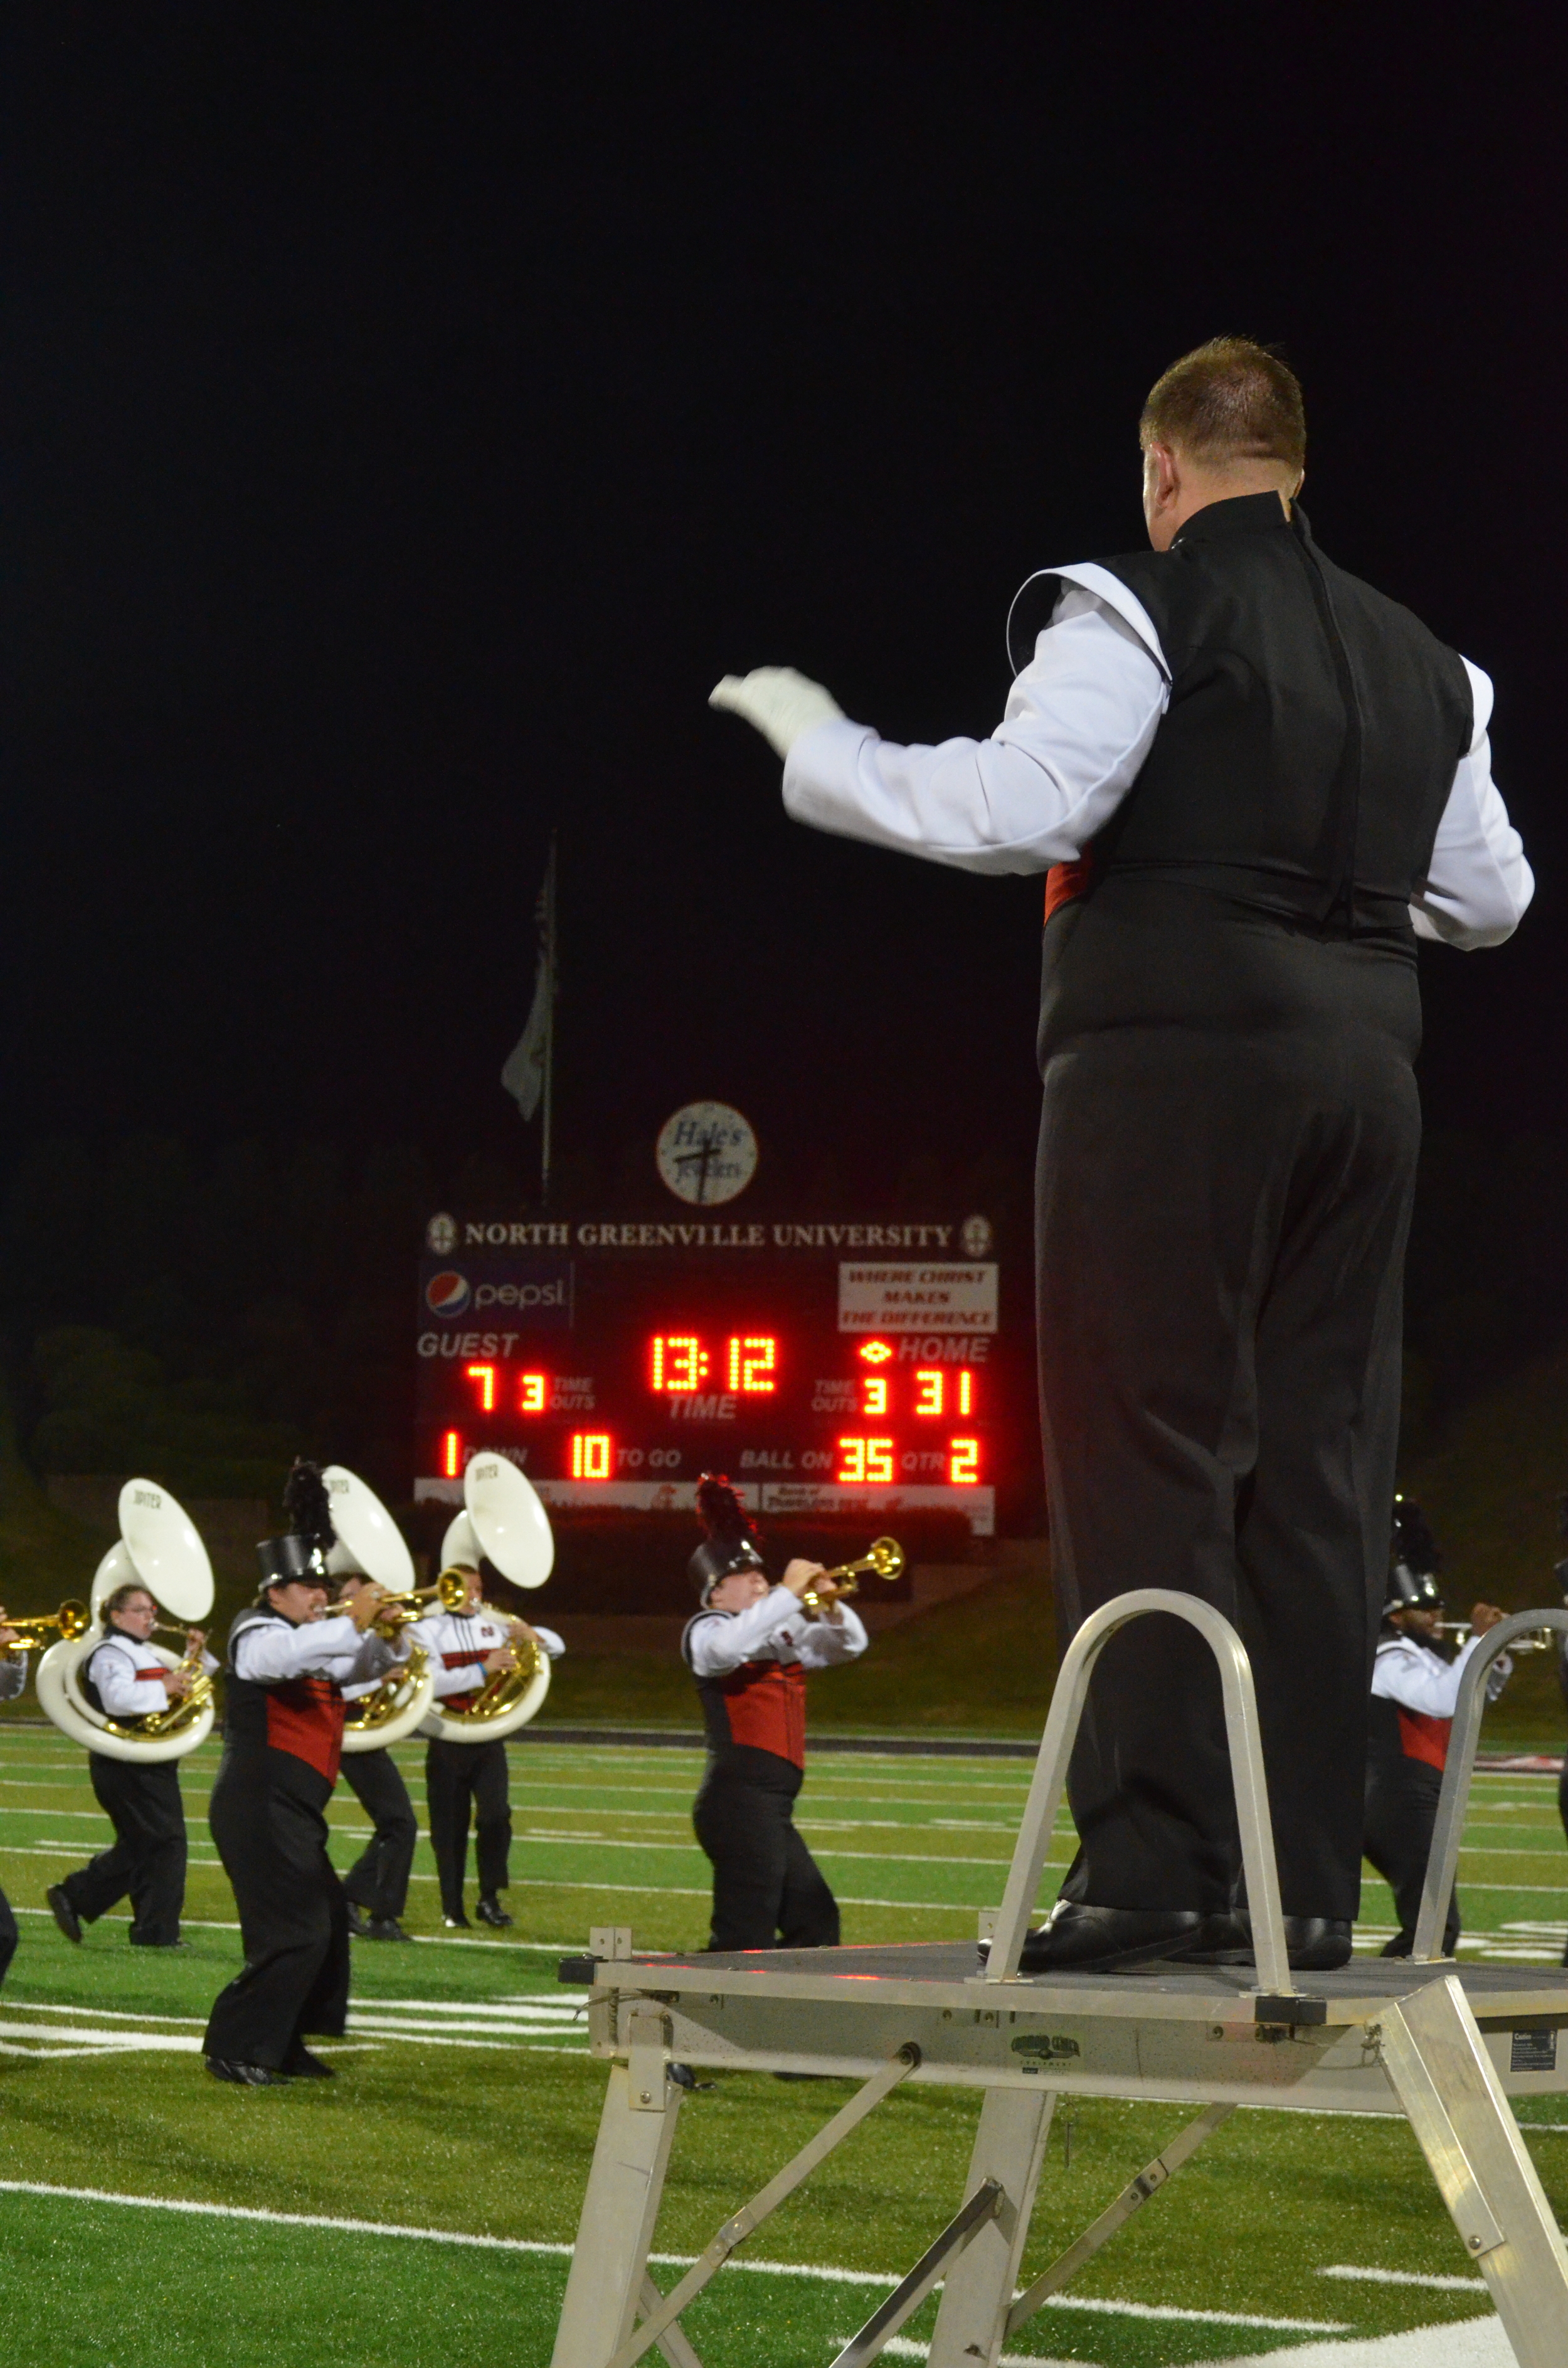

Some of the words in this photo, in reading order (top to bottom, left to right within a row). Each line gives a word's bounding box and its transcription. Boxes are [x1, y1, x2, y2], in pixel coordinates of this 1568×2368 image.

[465, 1223, 569, 1245] NORTH
[578, 1224, 765, 1246] GREENVILLE
[773, 1224, 952, 1247] UNIVERSITY
[849, 1270, 913, 1283] WHERE
[919, 1270, 985, 1283] CHRIST
[475, 1280, 564, 1310] pepsi
[884, 1290, 951, 1303] MAKES
[844, 1310, 874, 1324] THE
[881, 1310, 991, 1324] DIFFERENCE
[416, 1332, 520, 1358] GUEST
[898, 1336, 990, 1362] HOME
[654, 1337, 775, 1391] 13:12
[468, 1367, 494, 1410] 7
[522, 1375, 544, 1410] 3
[554, 1377, 593, 1393] TIME
[816, 1379, 855, 1394] TIME
[864, 1379, 886, 1414] 3
[916, 1371, 970, 1415] 31
[552, 1394, 595, 1410] OUTS
[670, 1393, 738, 1420] TIME
[812, 1397, 857, 1411] OUTS
[447, 1433, 456, 1476] 1
[463, 1446, 528, 1465] DWN
[573, 1435, 609, 1477] 10
[617, 1448, 644, 1467] TO
[649, 1448, 682, 1467] GO
[739, 1450, 794, 1469] BALL
[801, 1450, 834, 1470] ON
[839, 1438, 893, 1481] 35
[901, 1451, 945, 1471] QTR
[951, 1440, 978, 1482] 2
